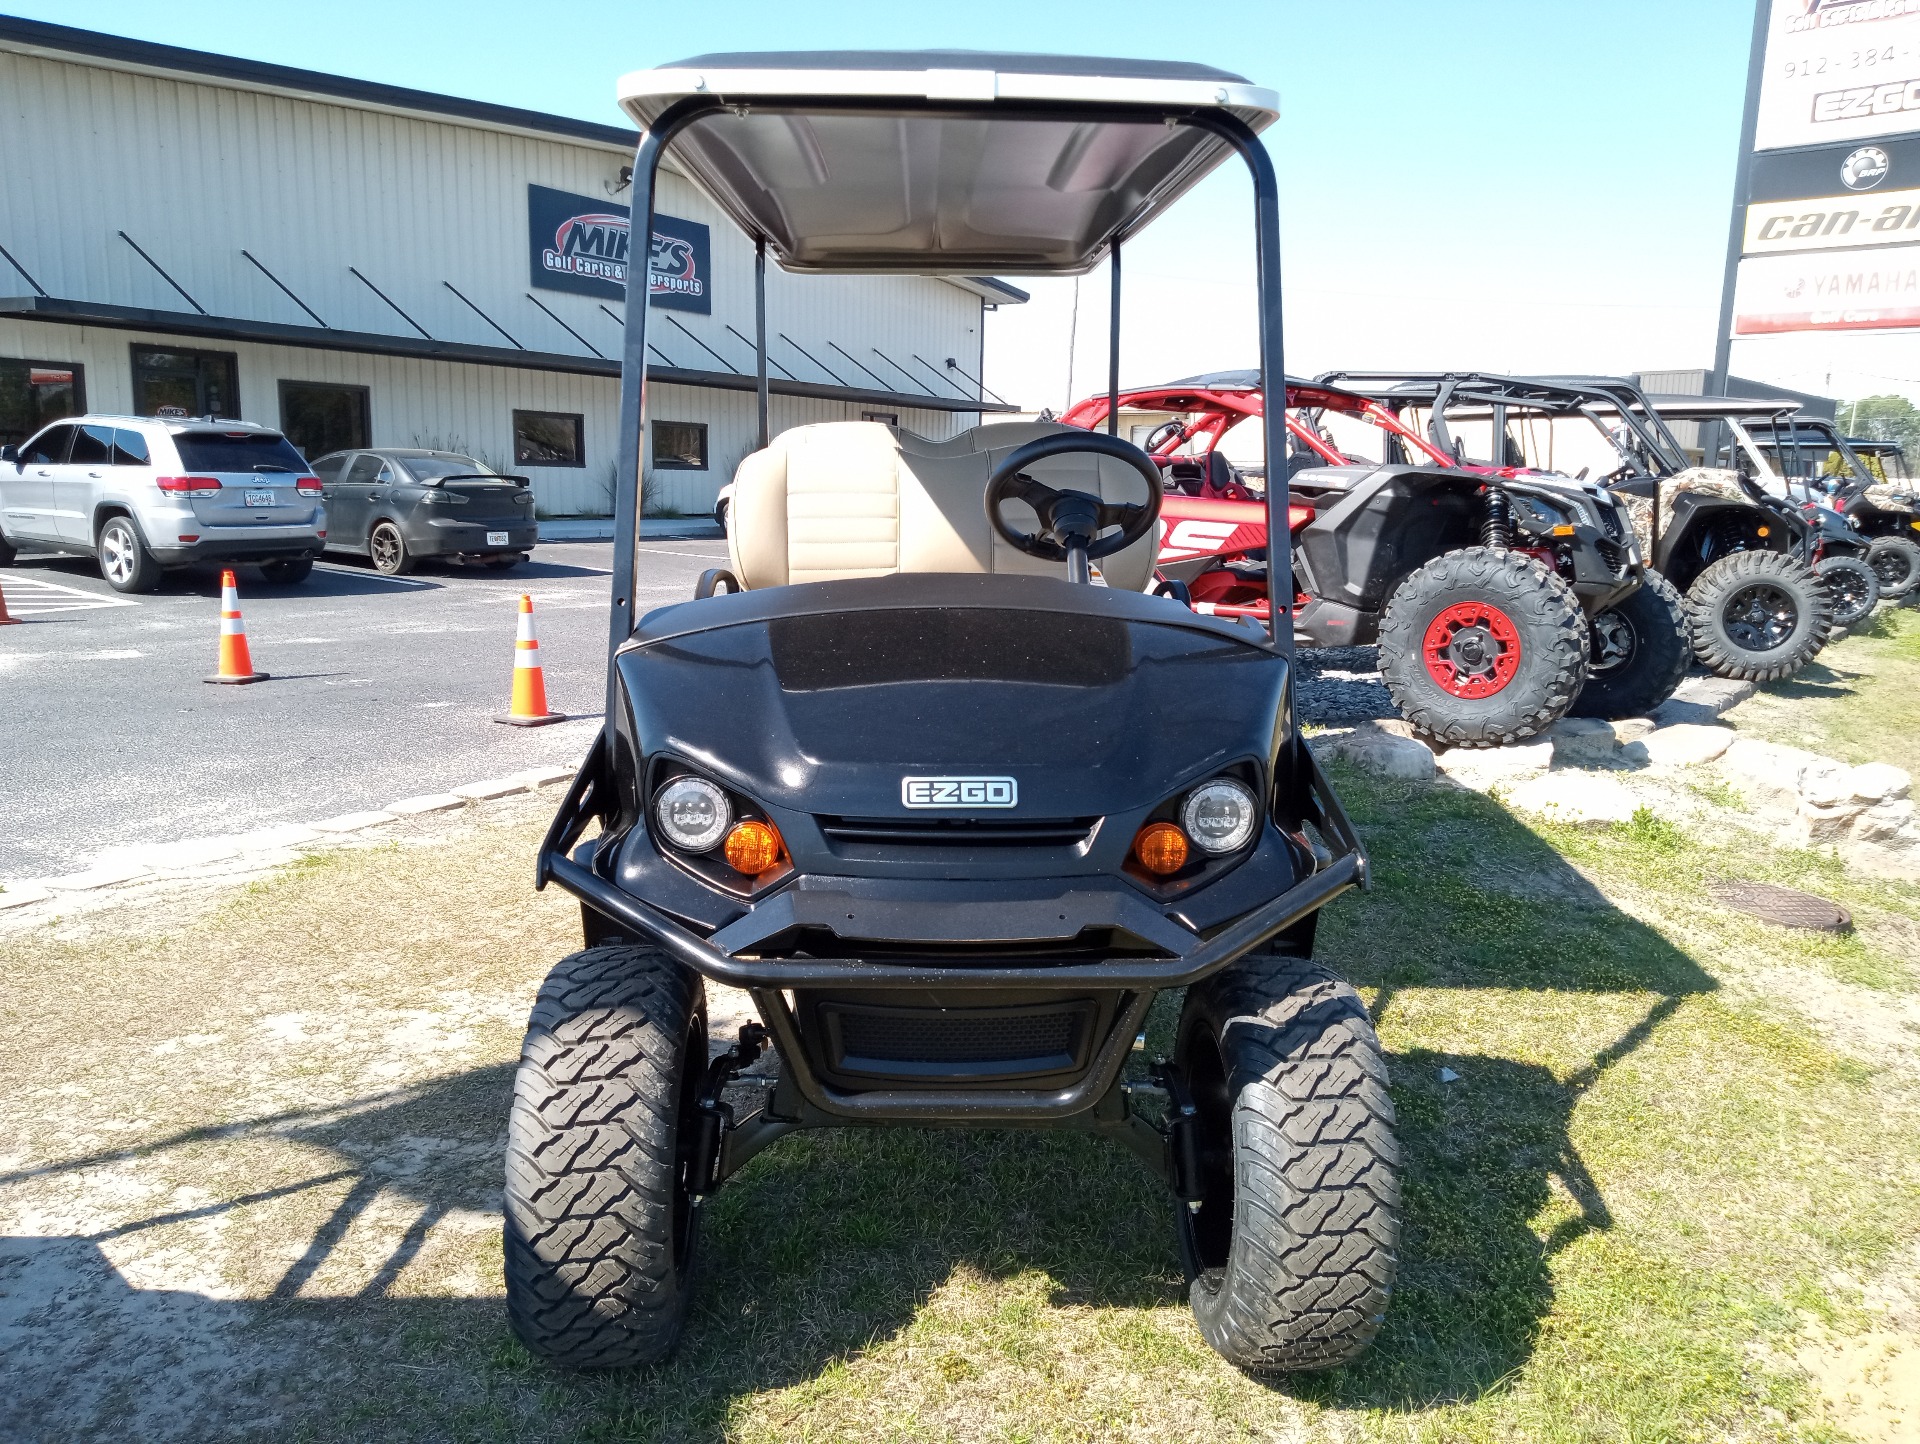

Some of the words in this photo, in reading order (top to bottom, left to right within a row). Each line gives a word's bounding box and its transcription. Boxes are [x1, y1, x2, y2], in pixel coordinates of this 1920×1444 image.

[1784, 45, 1920, 79] 912-384-
[1859, 167, 1886, 178] BRP
[546, 252, 572, 269] Golf
[576, 257, 612, 277] Carts
[614, 267, 623, 280] &
[1814, 269, 1918, 297] YAMAHA
[159, 407, 186, 417] MIKE'S
[909, 782, 1011, 802] EZGO
